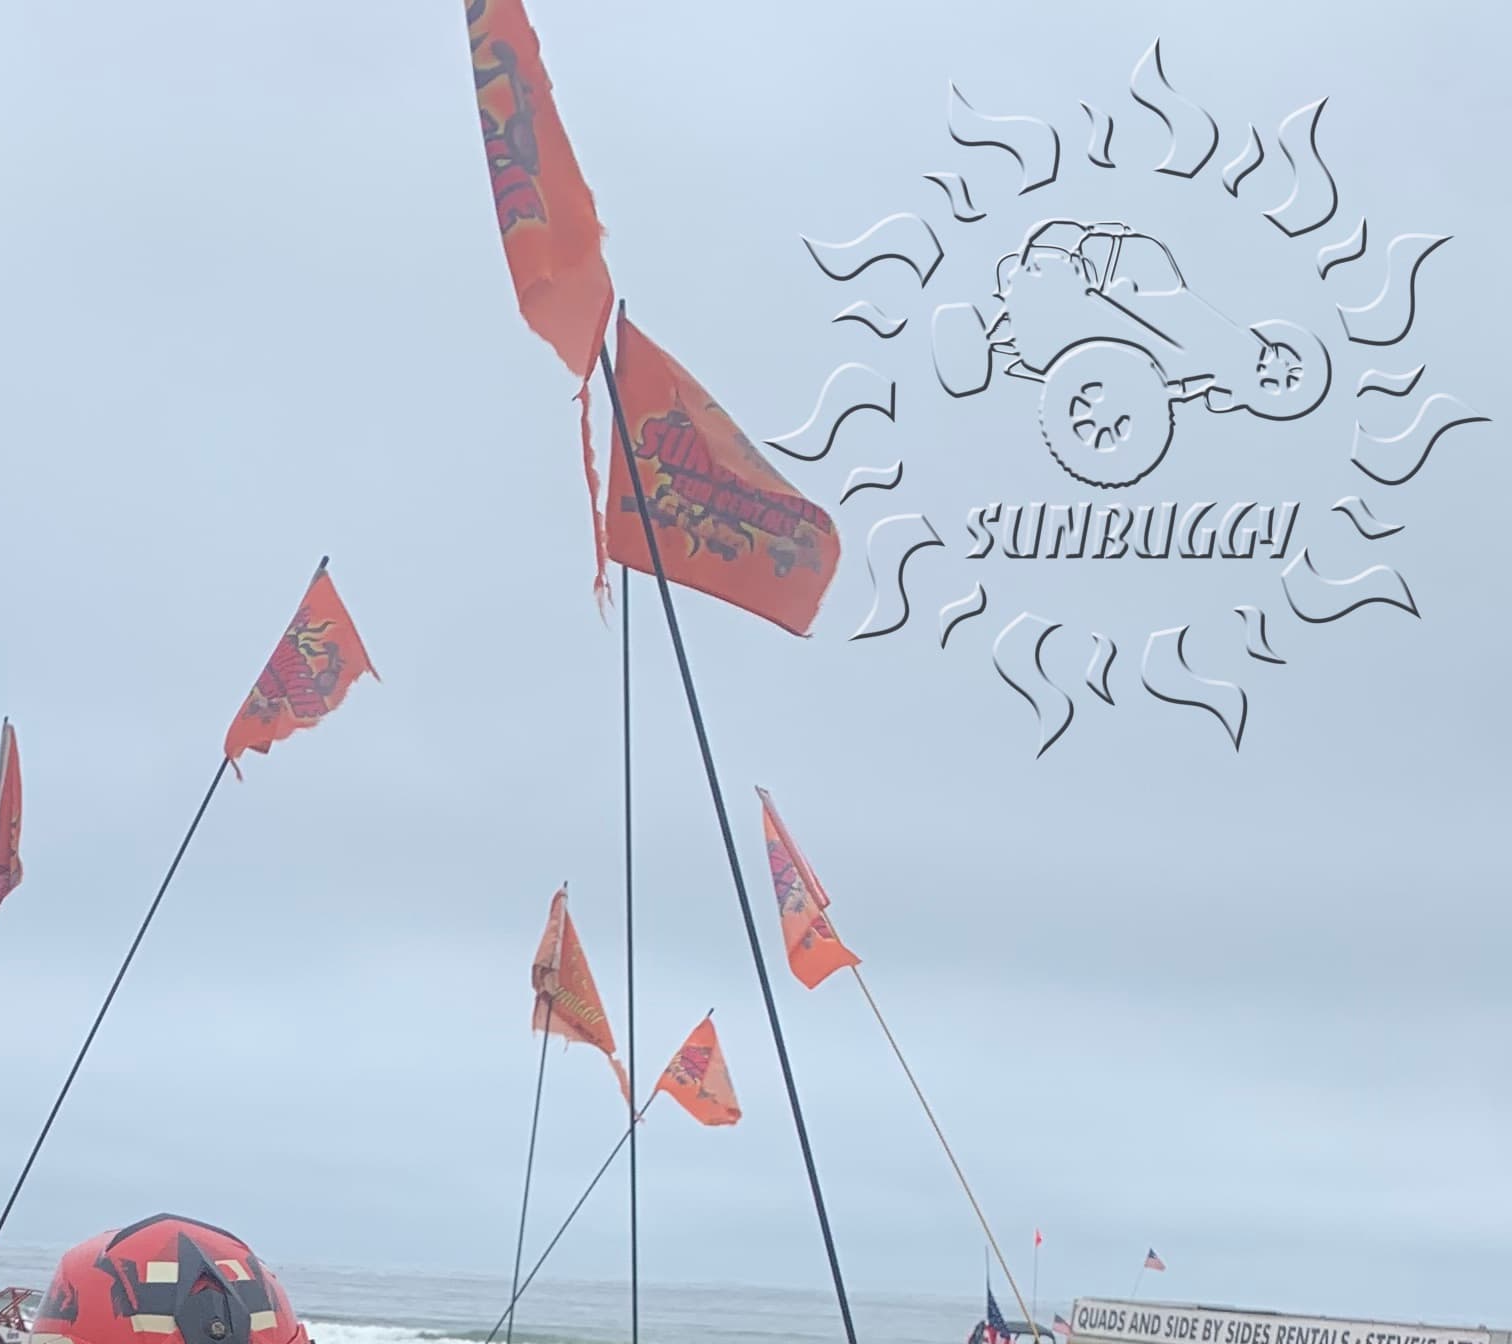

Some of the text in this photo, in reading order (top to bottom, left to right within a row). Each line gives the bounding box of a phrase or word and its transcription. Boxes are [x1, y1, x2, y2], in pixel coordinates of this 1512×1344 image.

[1078, 1307, 1126, 1334] QUADS
[1128, 1311, 1161, 1335] AND
[1164, 1315, 1199, 1339] SIDE
[1202, 1319, 1225, 1342] BY
